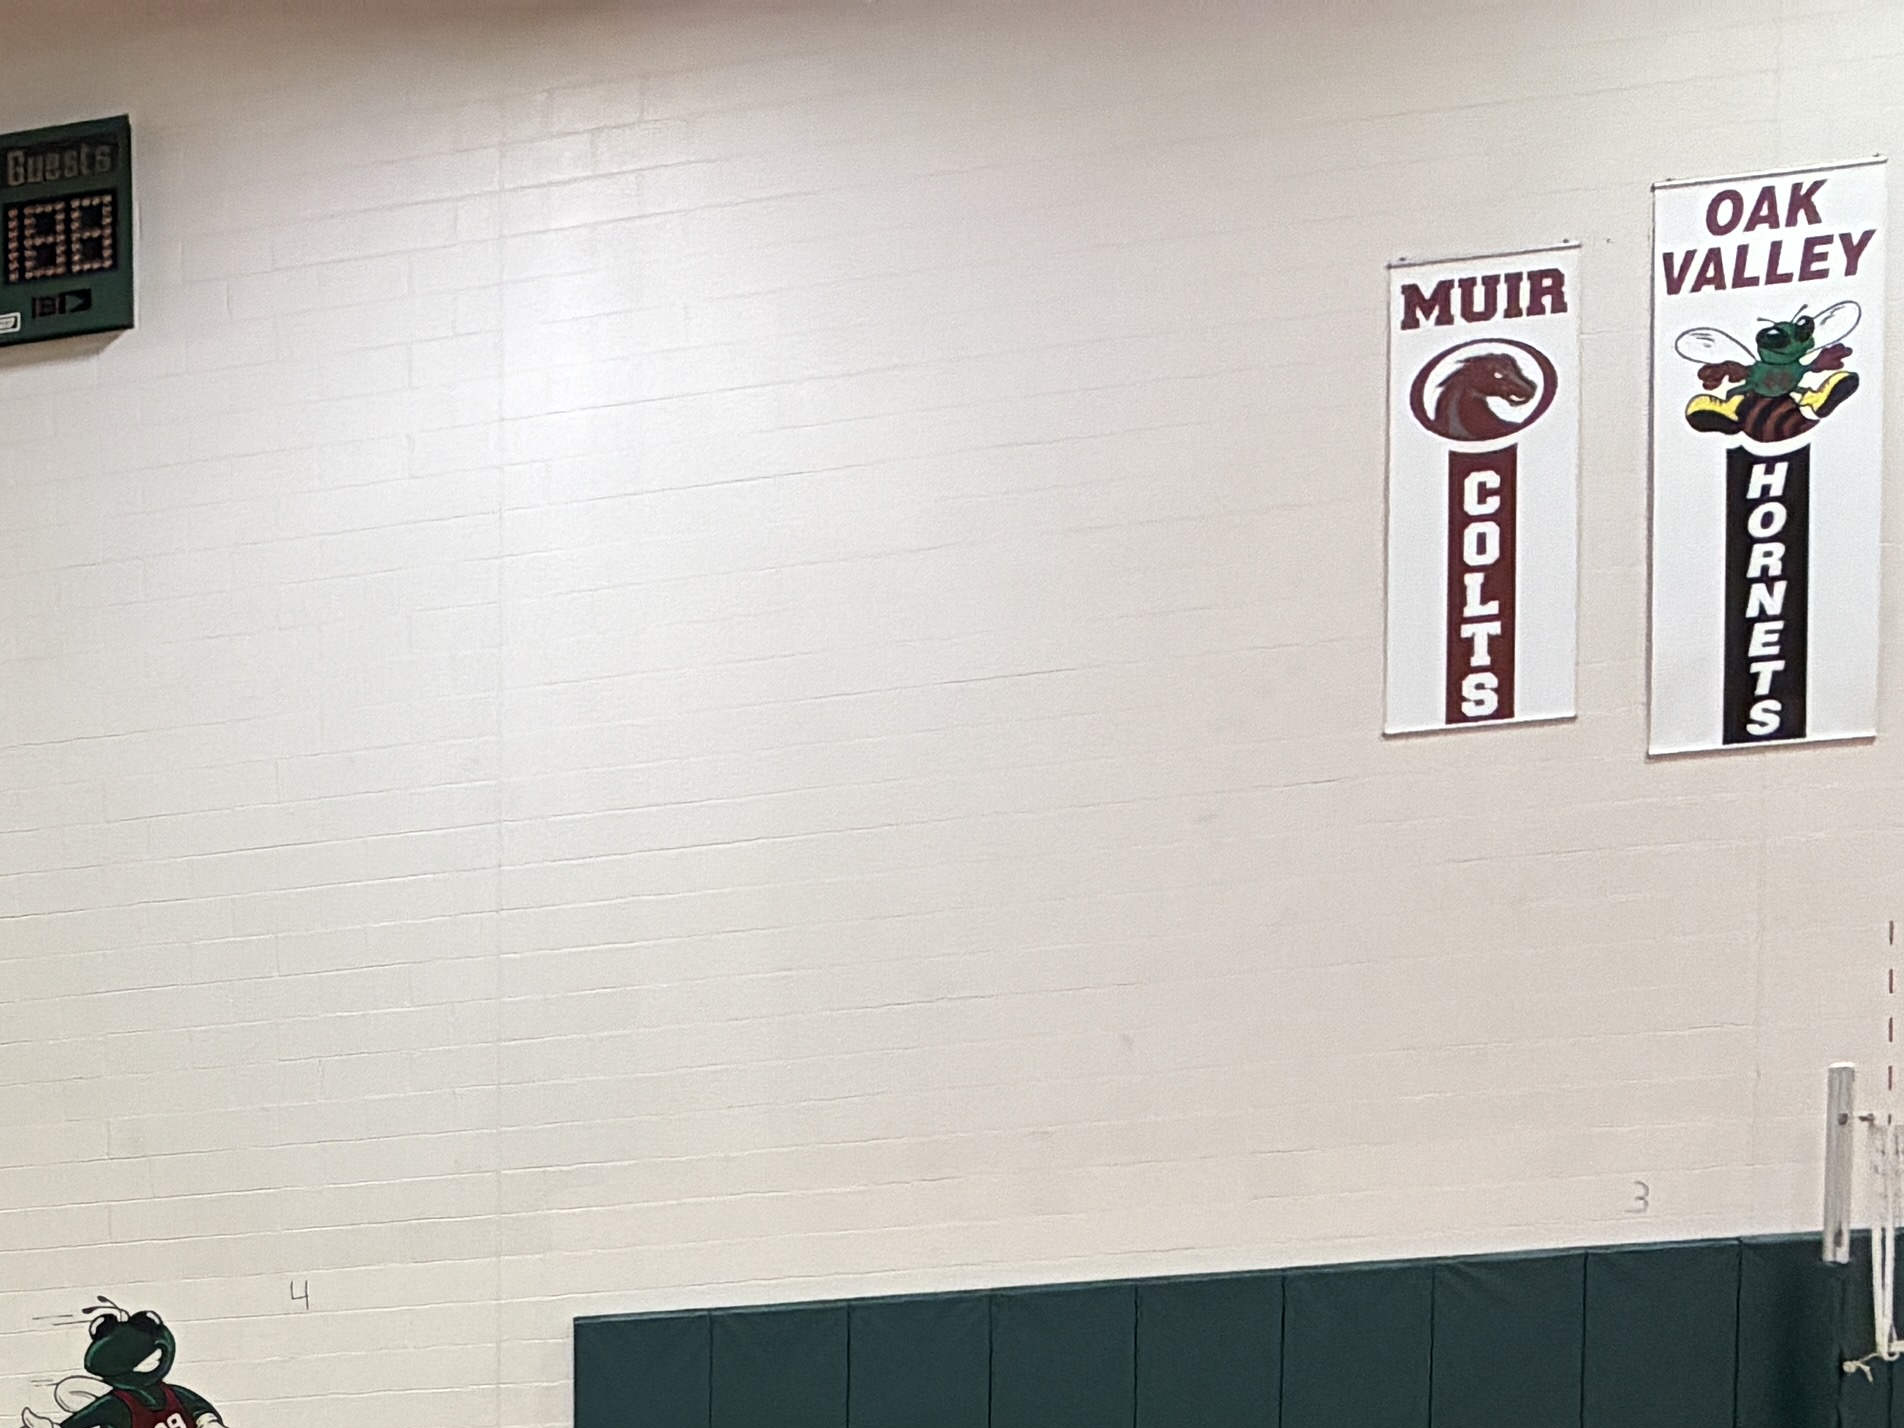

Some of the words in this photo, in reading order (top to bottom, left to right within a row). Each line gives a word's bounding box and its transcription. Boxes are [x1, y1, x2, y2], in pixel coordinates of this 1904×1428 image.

[7, 143, 112, 187] Guests
[1705, 179, 1828, 237] OAK
[1662, 228, 1876, 296] VALLEY
[1400, 267, 1569, 331] MUIR
[1460, 470, 1502, 718] COLTS
[1744, 461, 1789, 736] HORNETS
